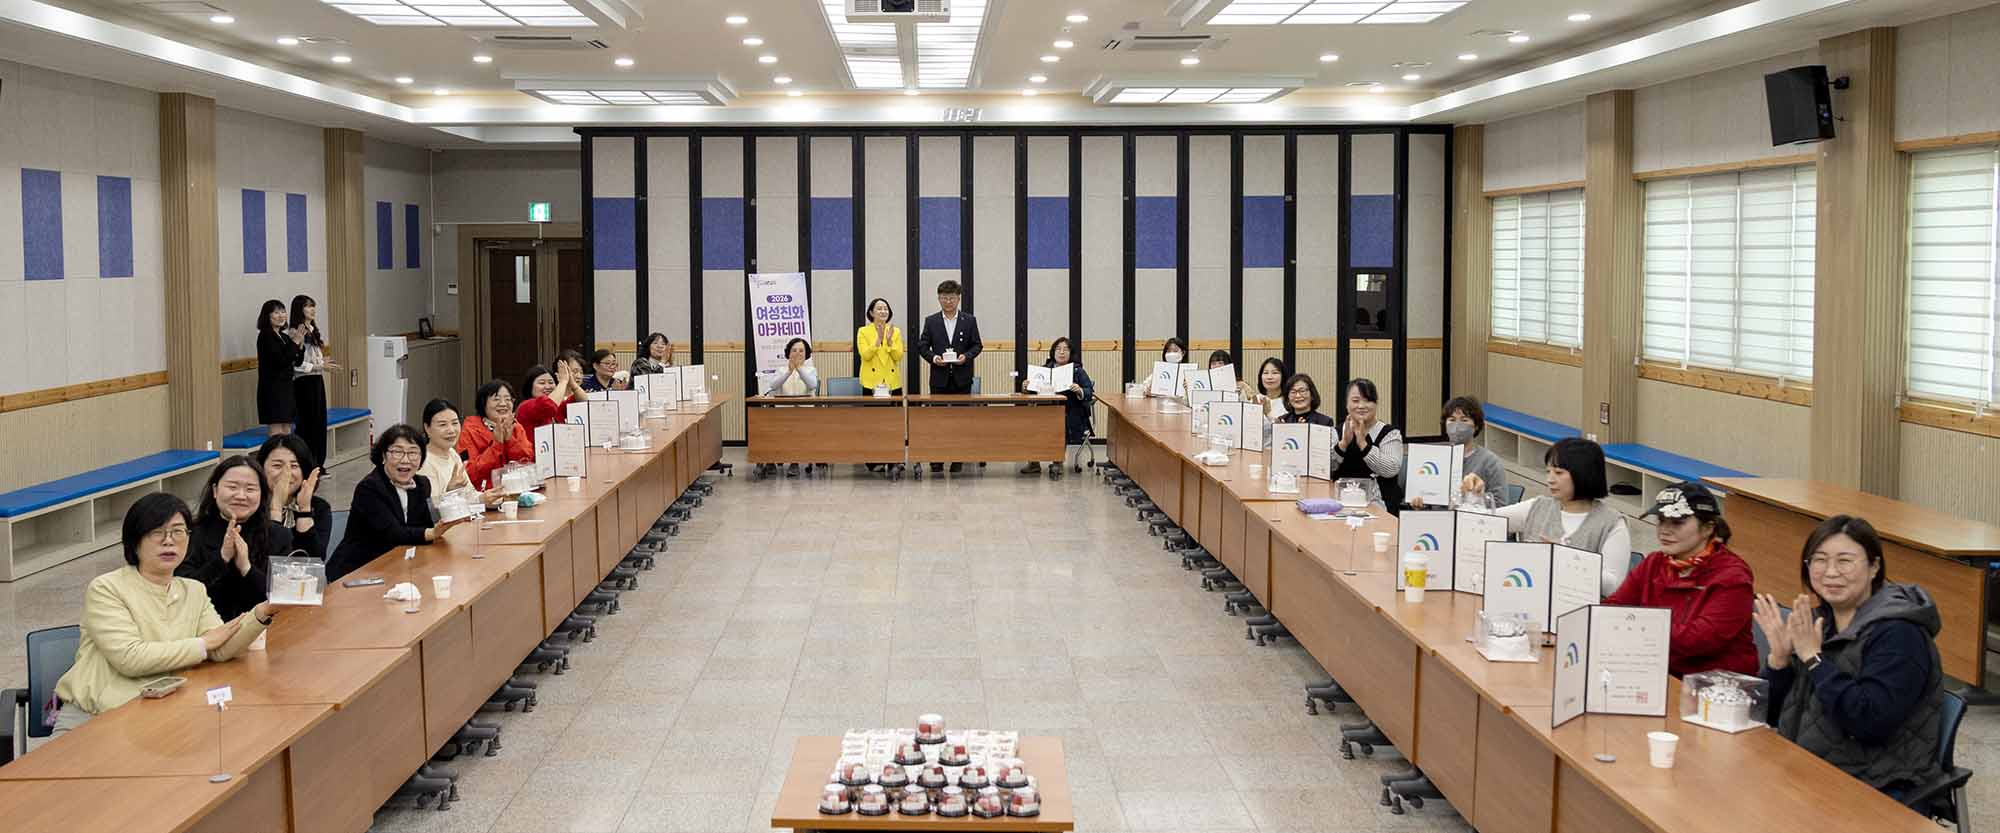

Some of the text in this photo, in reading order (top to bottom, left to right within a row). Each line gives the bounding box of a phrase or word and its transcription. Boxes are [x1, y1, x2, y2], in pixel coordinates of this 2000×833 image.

[770, 295, 789, 303] 2026
[756, 305, 804, 320] 여성친화
[758, 321, 806, 337] 아카데미
